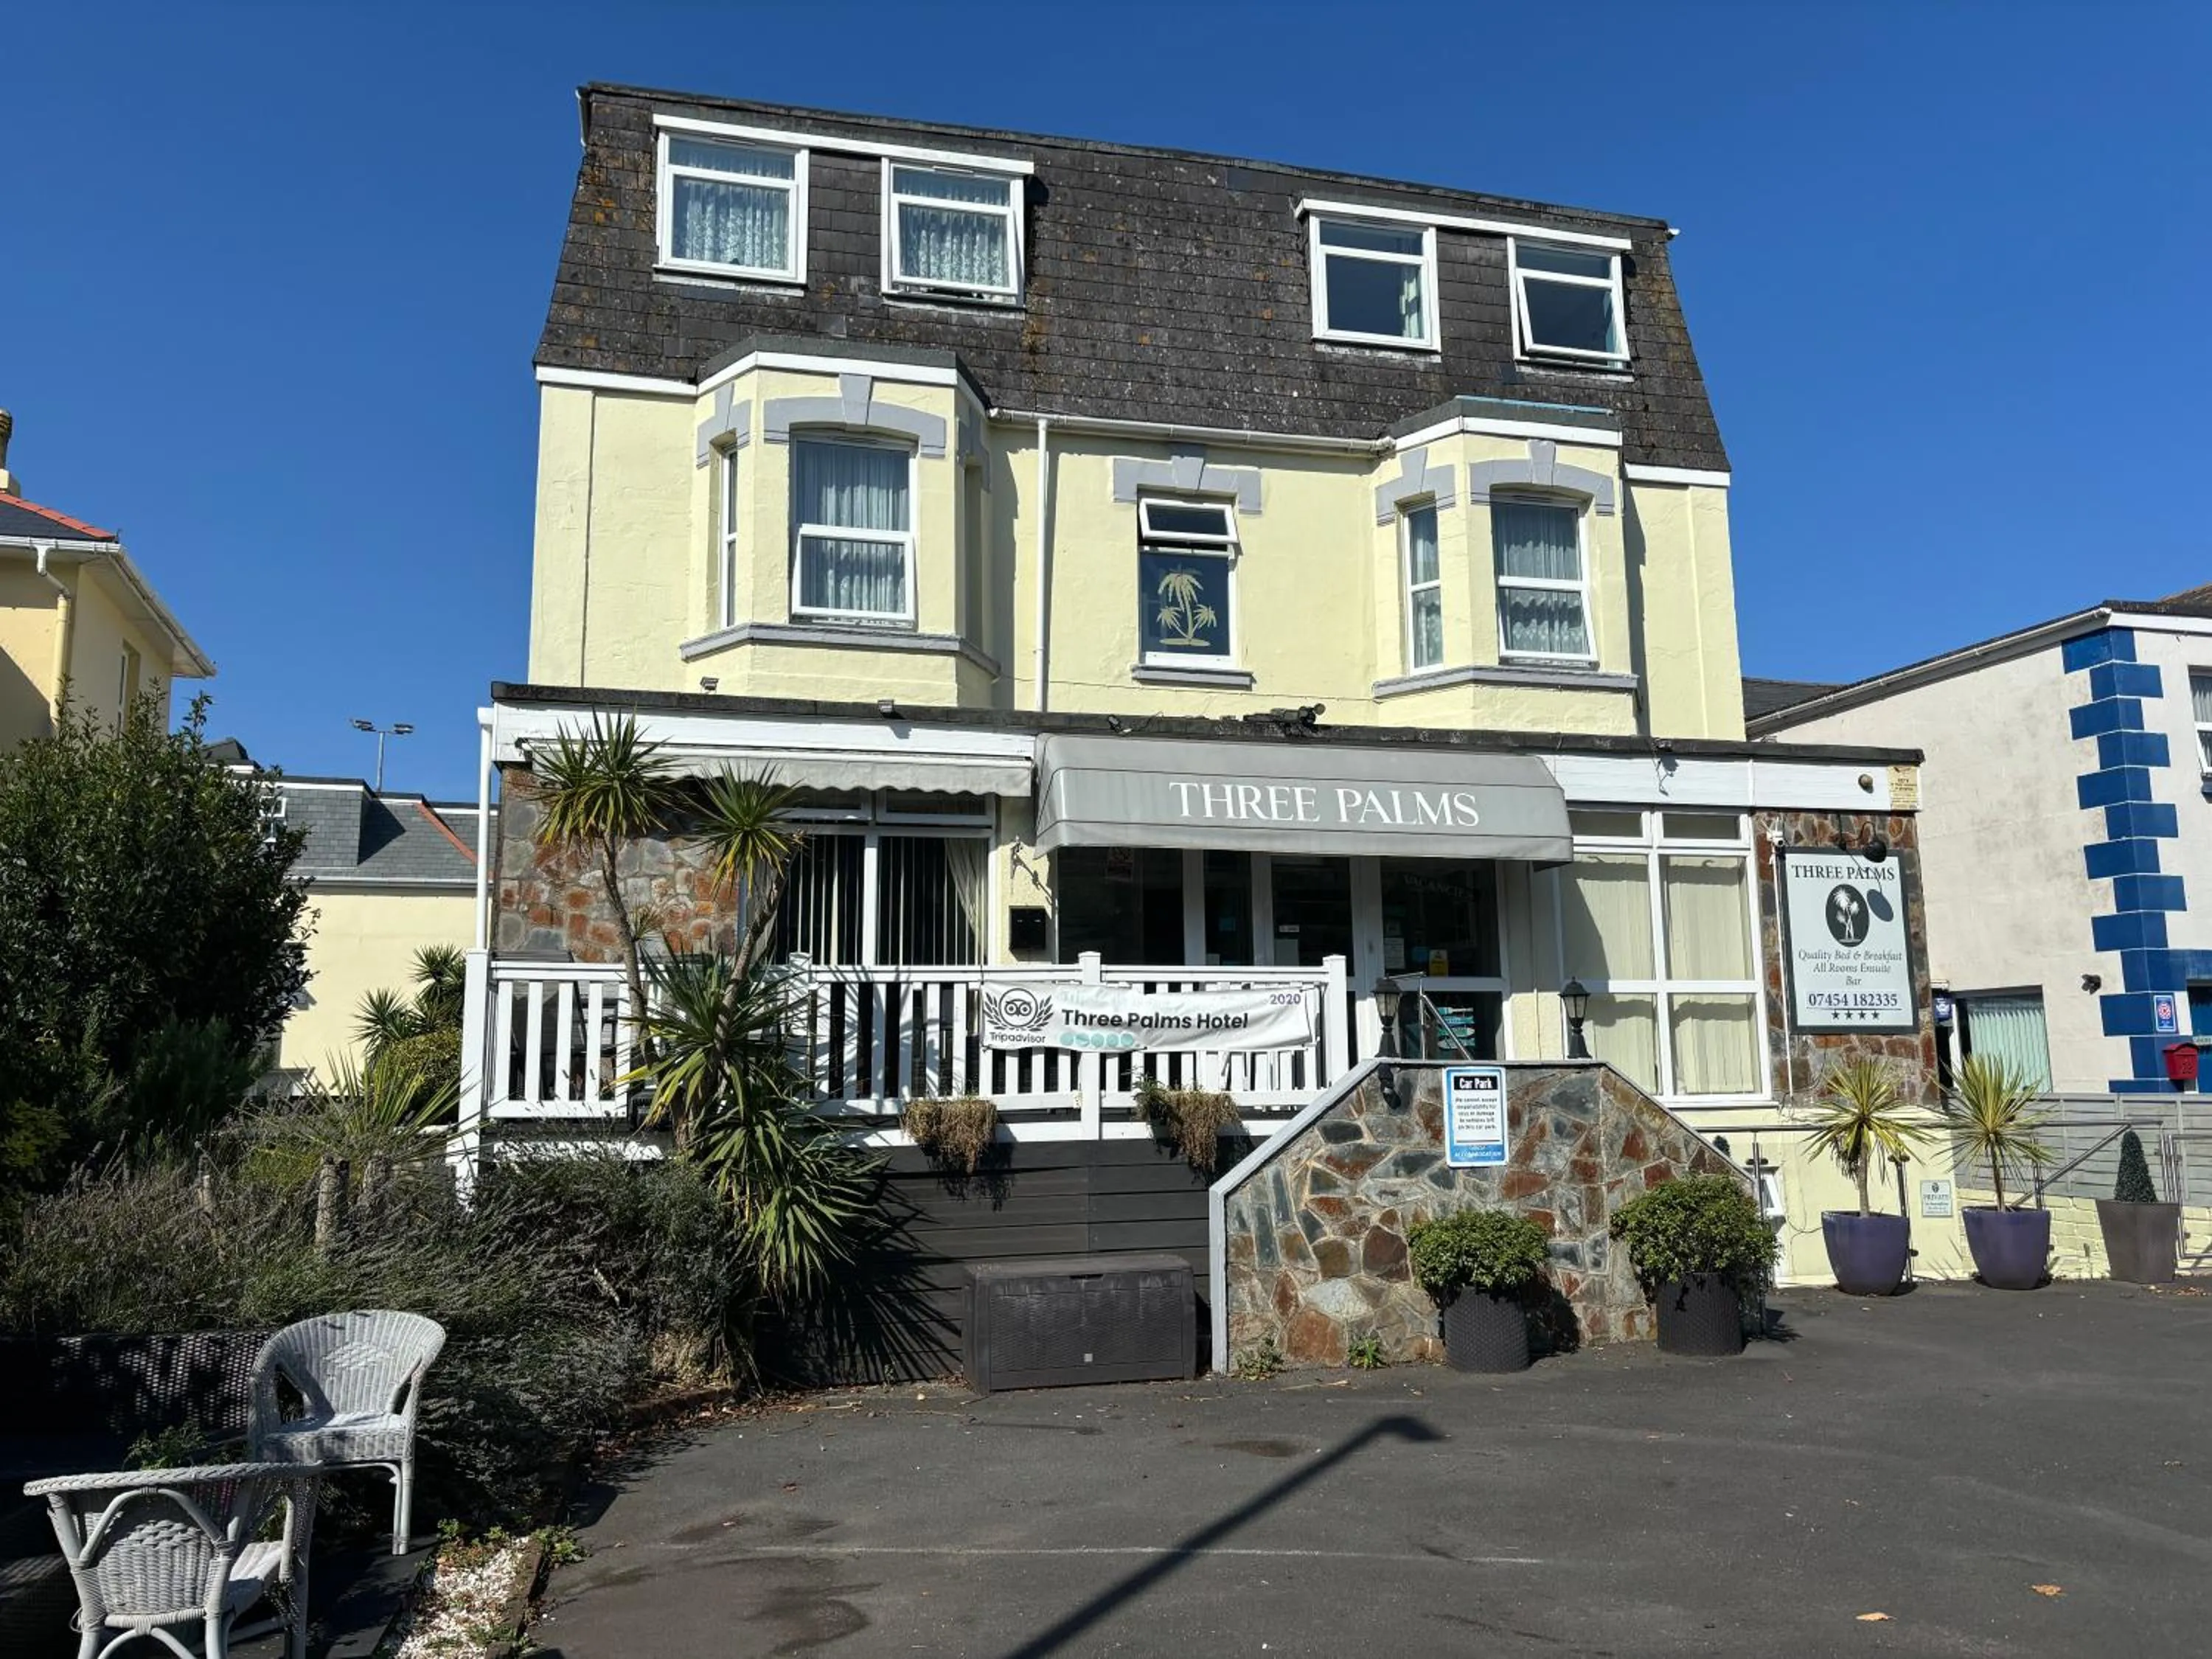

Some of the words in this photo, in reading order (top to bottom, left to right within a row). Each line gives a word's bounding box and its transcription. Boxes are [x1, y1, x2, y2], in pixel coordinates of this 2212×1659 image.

[1169, 782, 1321, 822] THREE
[1335, 788, 1480, 827] PALMS
[1792, 865, 1843, 879] THREE
[1846, 866, 1895, 880] PALMS
[1798, 948, 1832, 963] Quality
[1834, 949, 1851, 959] Bed
[1853, 951, 1862, 960] &
[1863, 950, 1902, 964] Breakfast
[1813, 962, 1826, 973] All
[1829, 962, 1858, 973] Rooms
[1860, 962, 1891, 973] Ensuite
[1846, 975, 1863, 986] Bar
[1270, 994, 1301, 1005] 2020
[1809, 993, 1849, 1006] 07454
[1854, 994, 1898, 1007] 182335
[1062, 1009, 1124, 1027] Three
[1127, 1011, 1192, 1029] Palms
[1197, 1012, 1249, 1029] Hotel
[990, 1032, 1046, 1043] Tripadvisor
[1459, 1077, 1473, 1089] Car
[1474, 1077, 1492, 1089] Park
